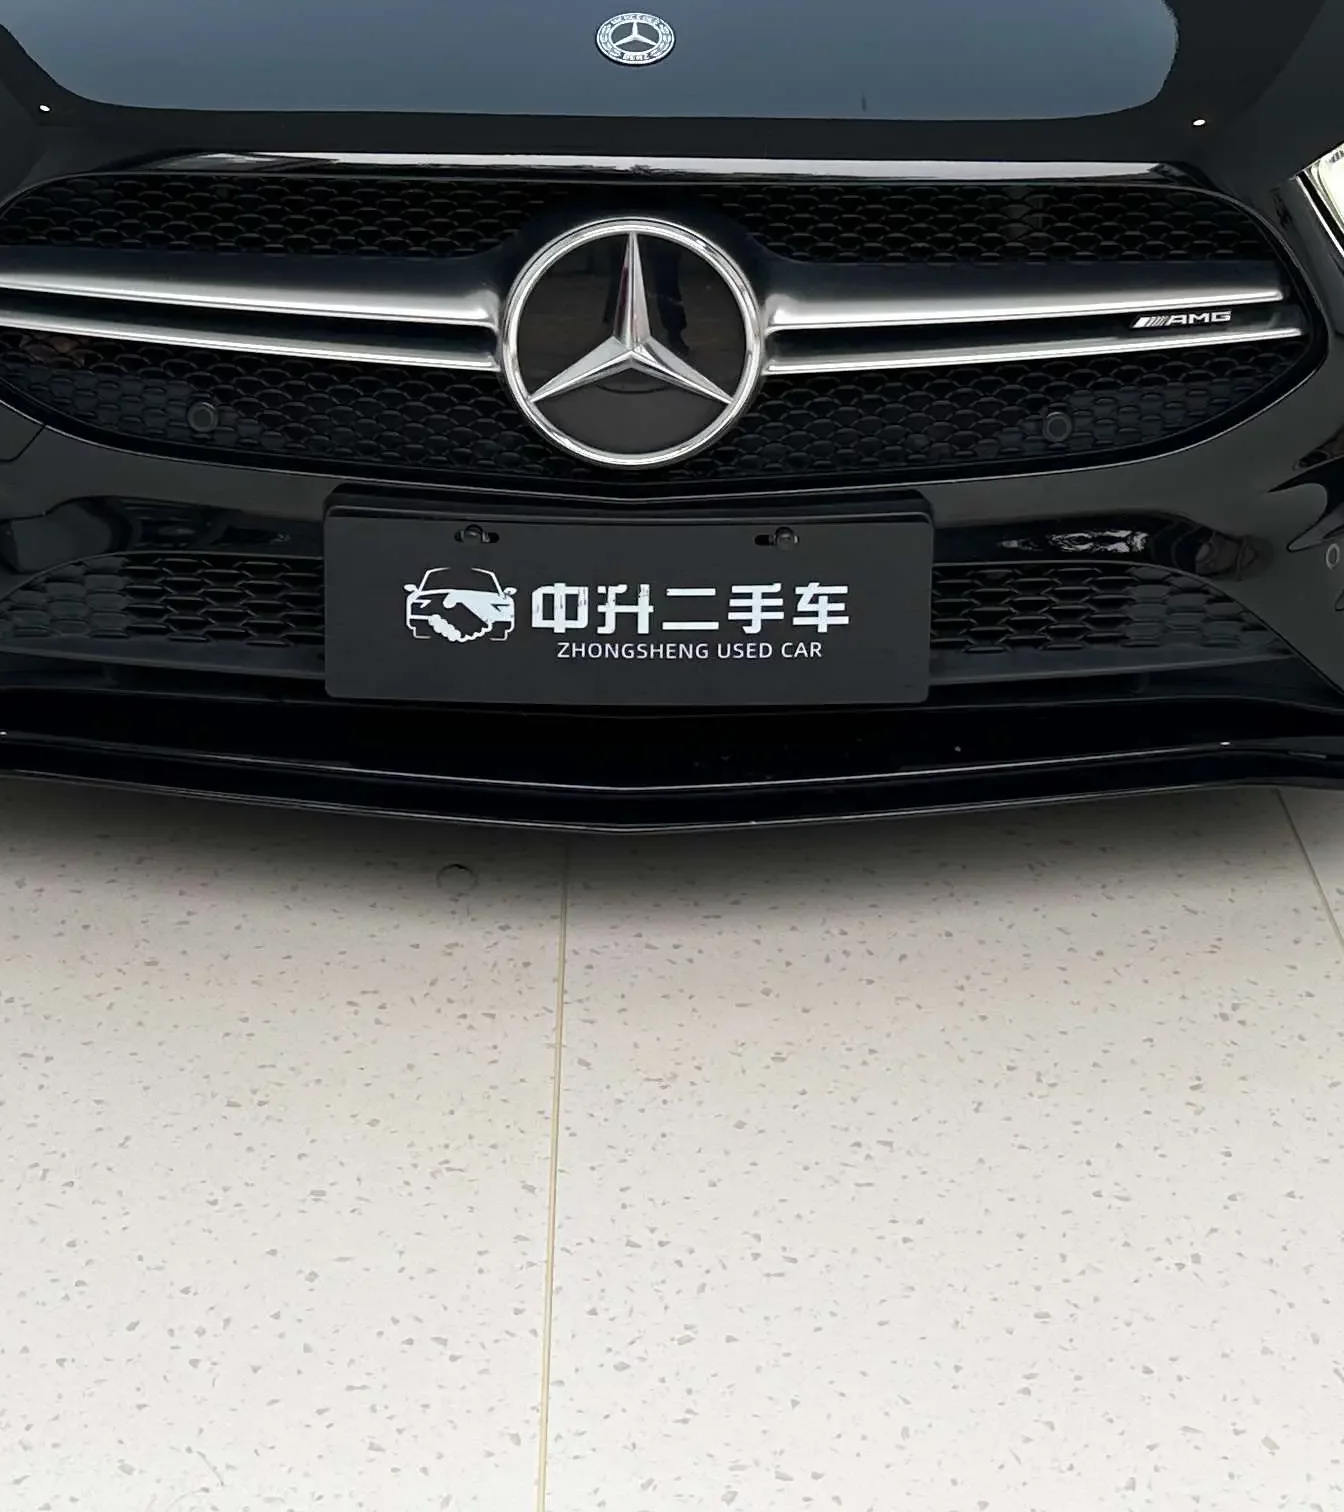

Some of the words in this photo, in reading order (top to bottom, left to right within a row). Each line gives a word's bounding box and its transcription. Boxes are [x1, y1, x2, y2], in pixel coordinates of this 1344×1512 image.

[1167, 311, 1231, 325] AMG
[531, 582, 850, 634] 中升二手车
[557, 641, 709, 660] ZHONGSHENG
[717, 641, 772, 659] USED
[780, 641, 823, 659] CAR
